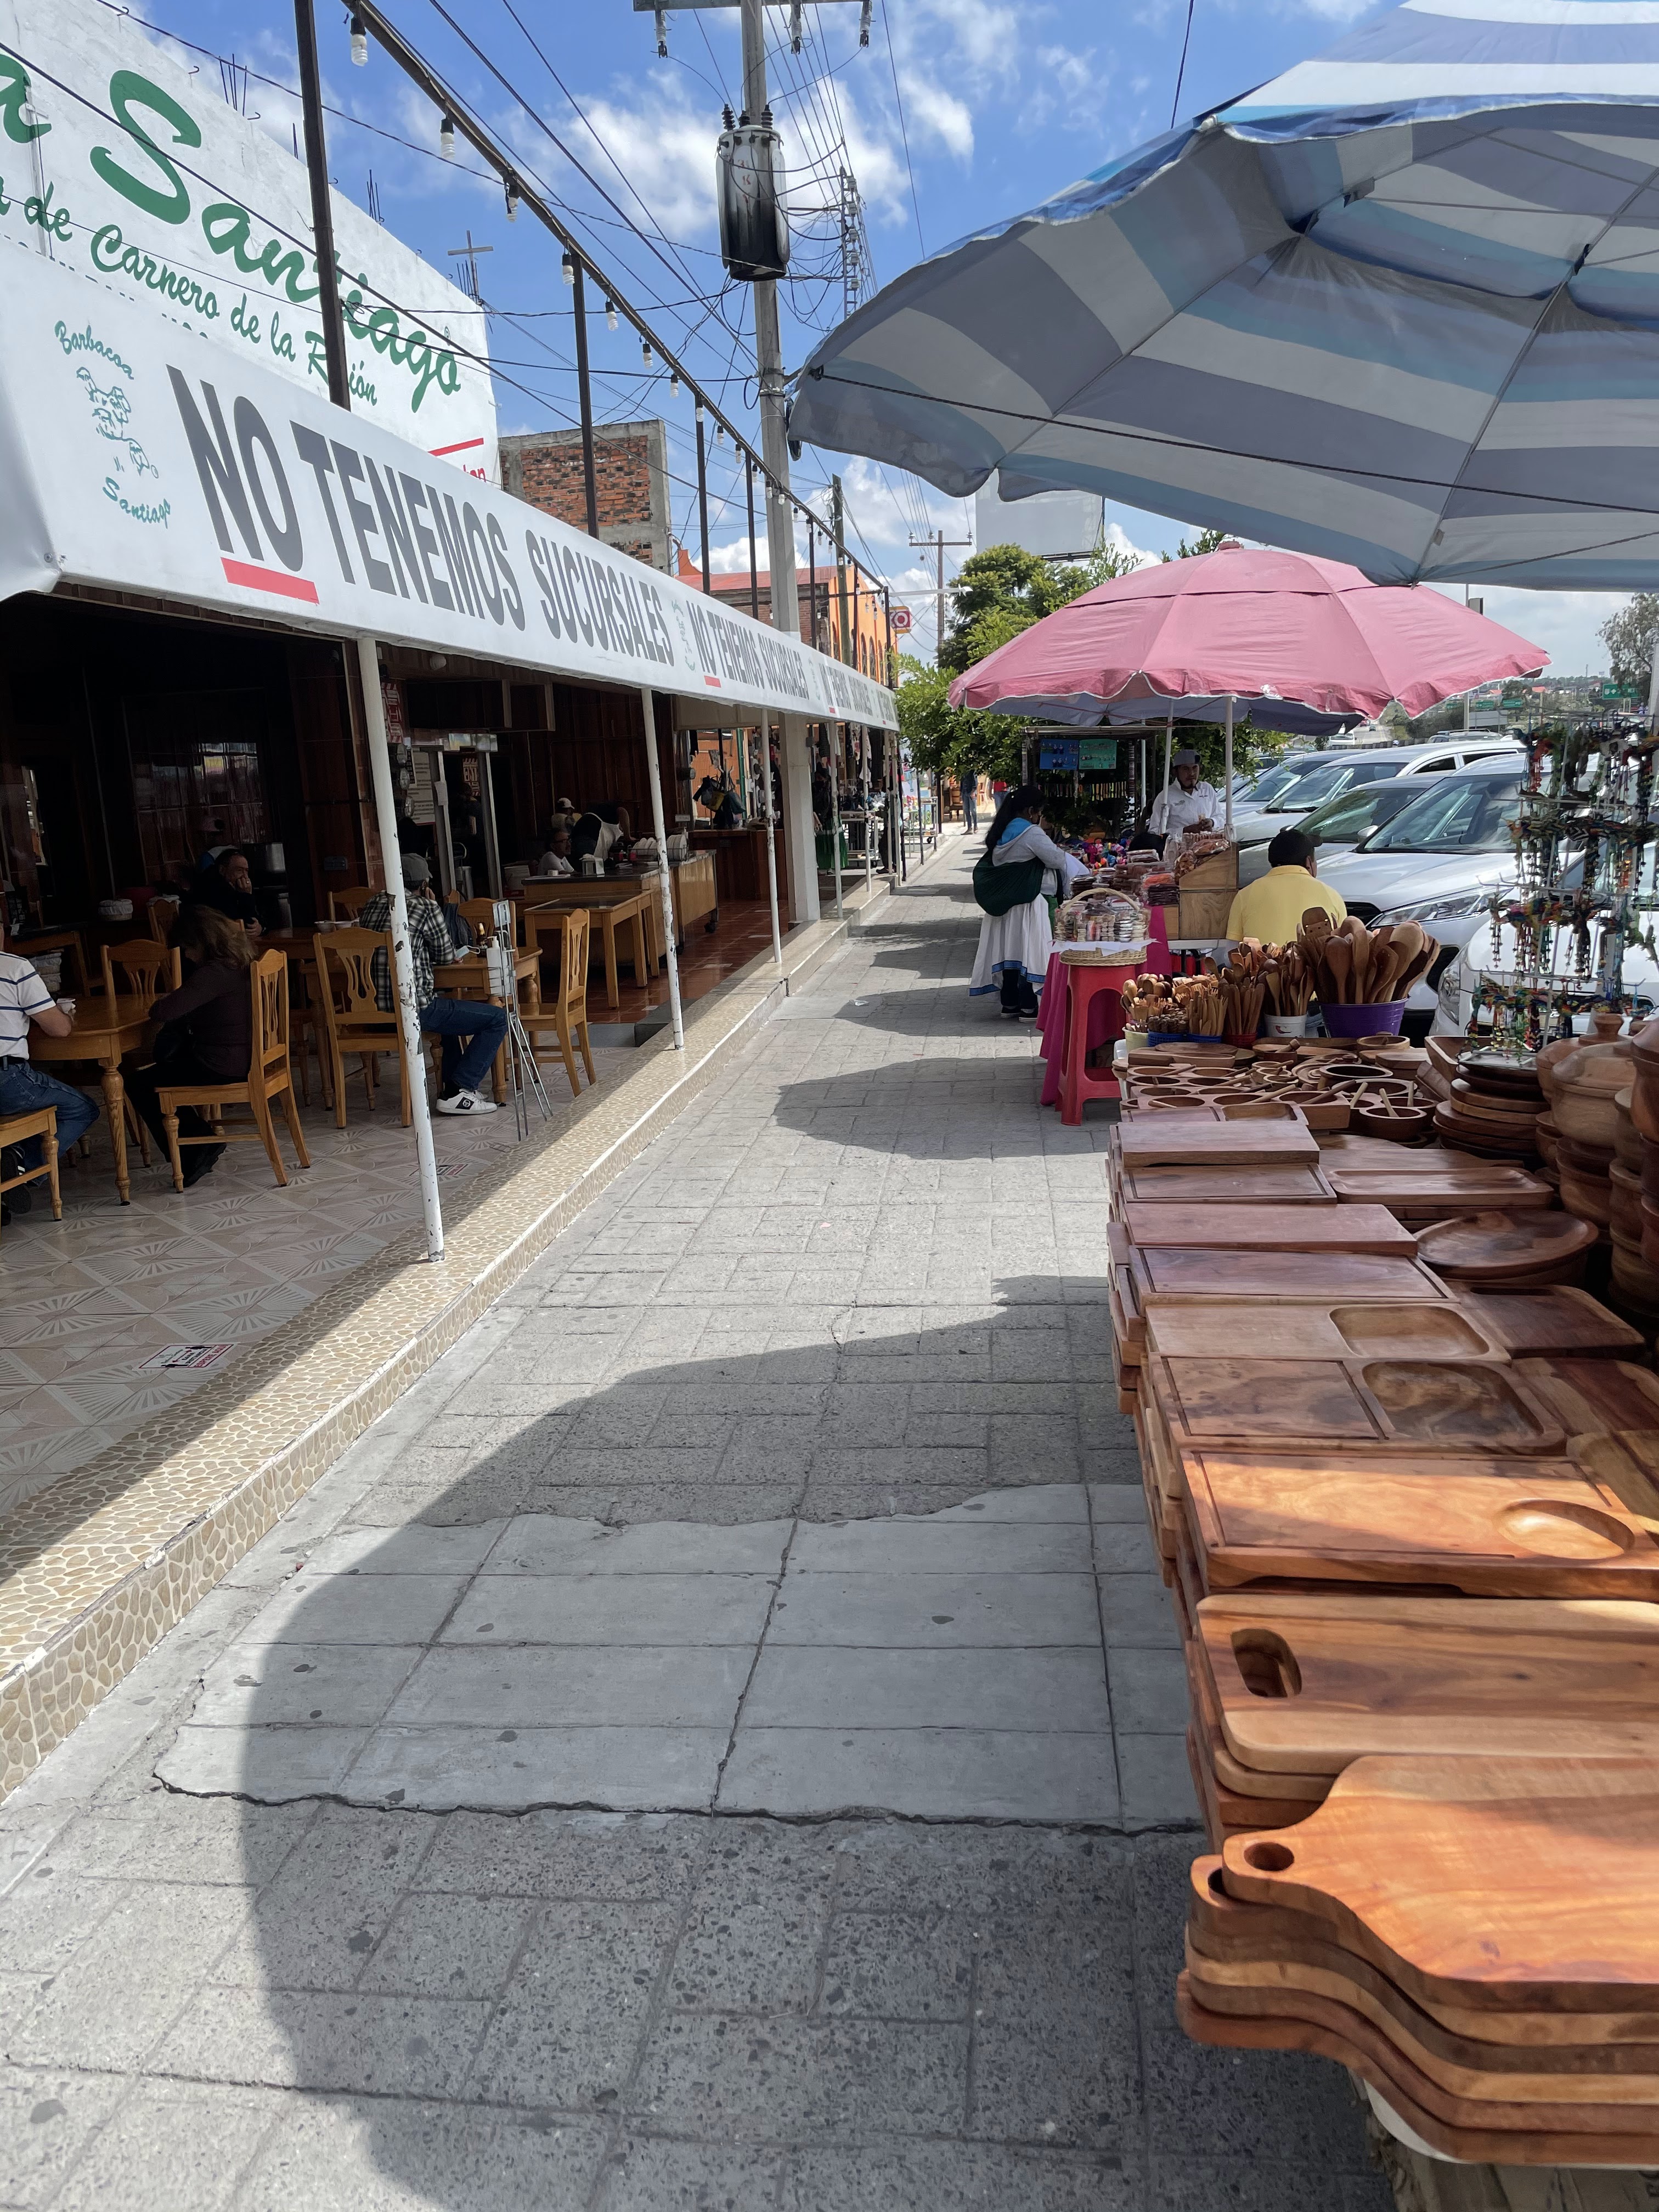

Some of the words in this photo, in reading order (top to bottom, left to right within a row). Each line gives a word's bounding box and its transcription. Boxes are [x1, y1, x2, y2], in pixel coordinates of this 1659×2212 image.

[24, 180, 72, 241] de
[91, 224, 219, 319] Carnero
[230, 293, 261, 343] de
[270, 311, 296, 362] la
[305, 330, 377, 406] Rión
[54, 320, 134, 380] Barbacoa
[102, 476, 171, 529] Santiago
[166, 364, 303, 572] NO
[289, 420, 526, 631] TENEMOS
[526, 529, 674, 667] SUCURSALES
[686, 600, 716, 676] NO
[706, 610, 765, 690] TENEMOS
[757, 633, 810, 701] SUCURSALES
